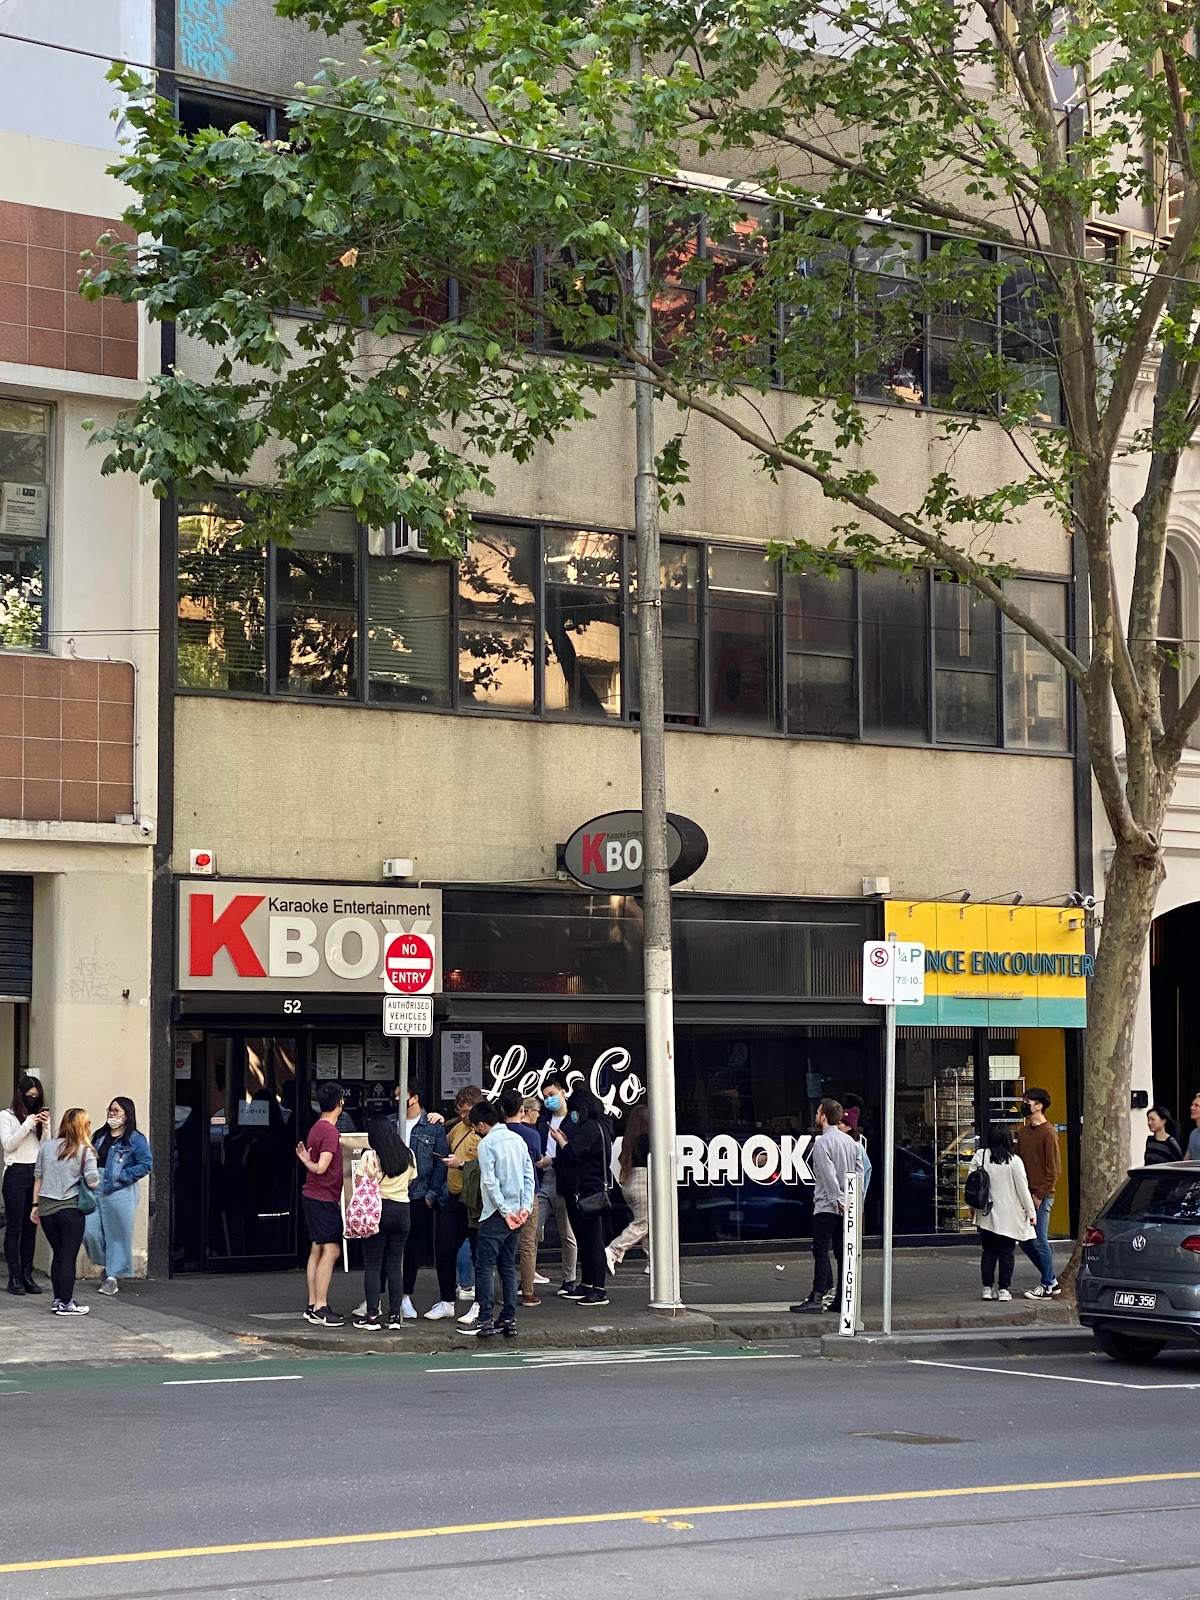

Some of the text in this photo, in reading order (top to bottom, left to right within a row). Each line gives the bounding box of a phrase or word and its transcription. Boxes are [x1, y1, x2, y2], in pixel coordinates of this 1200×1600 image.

[582, 832, 643, 875] KBO
[268, 897, 430, 916] Karaoke Entertainment
[402, 943, 417, 955] NO
[924, 949, 1095, 977] NCE ENCOUNTER
[391, 971, 426, 983] ENTRY
[283, 1000, 302, 1014] 52
[388, 1001, 429, 1010] AUTHORISED
[390, 1012, 427, 1020] VEHICLES
[389, 1022, 427, 1031] EXCEPTED
[481, 1044, 647, 1119] Let's Go
[845, 1243, 854, 1312] RIGHT
